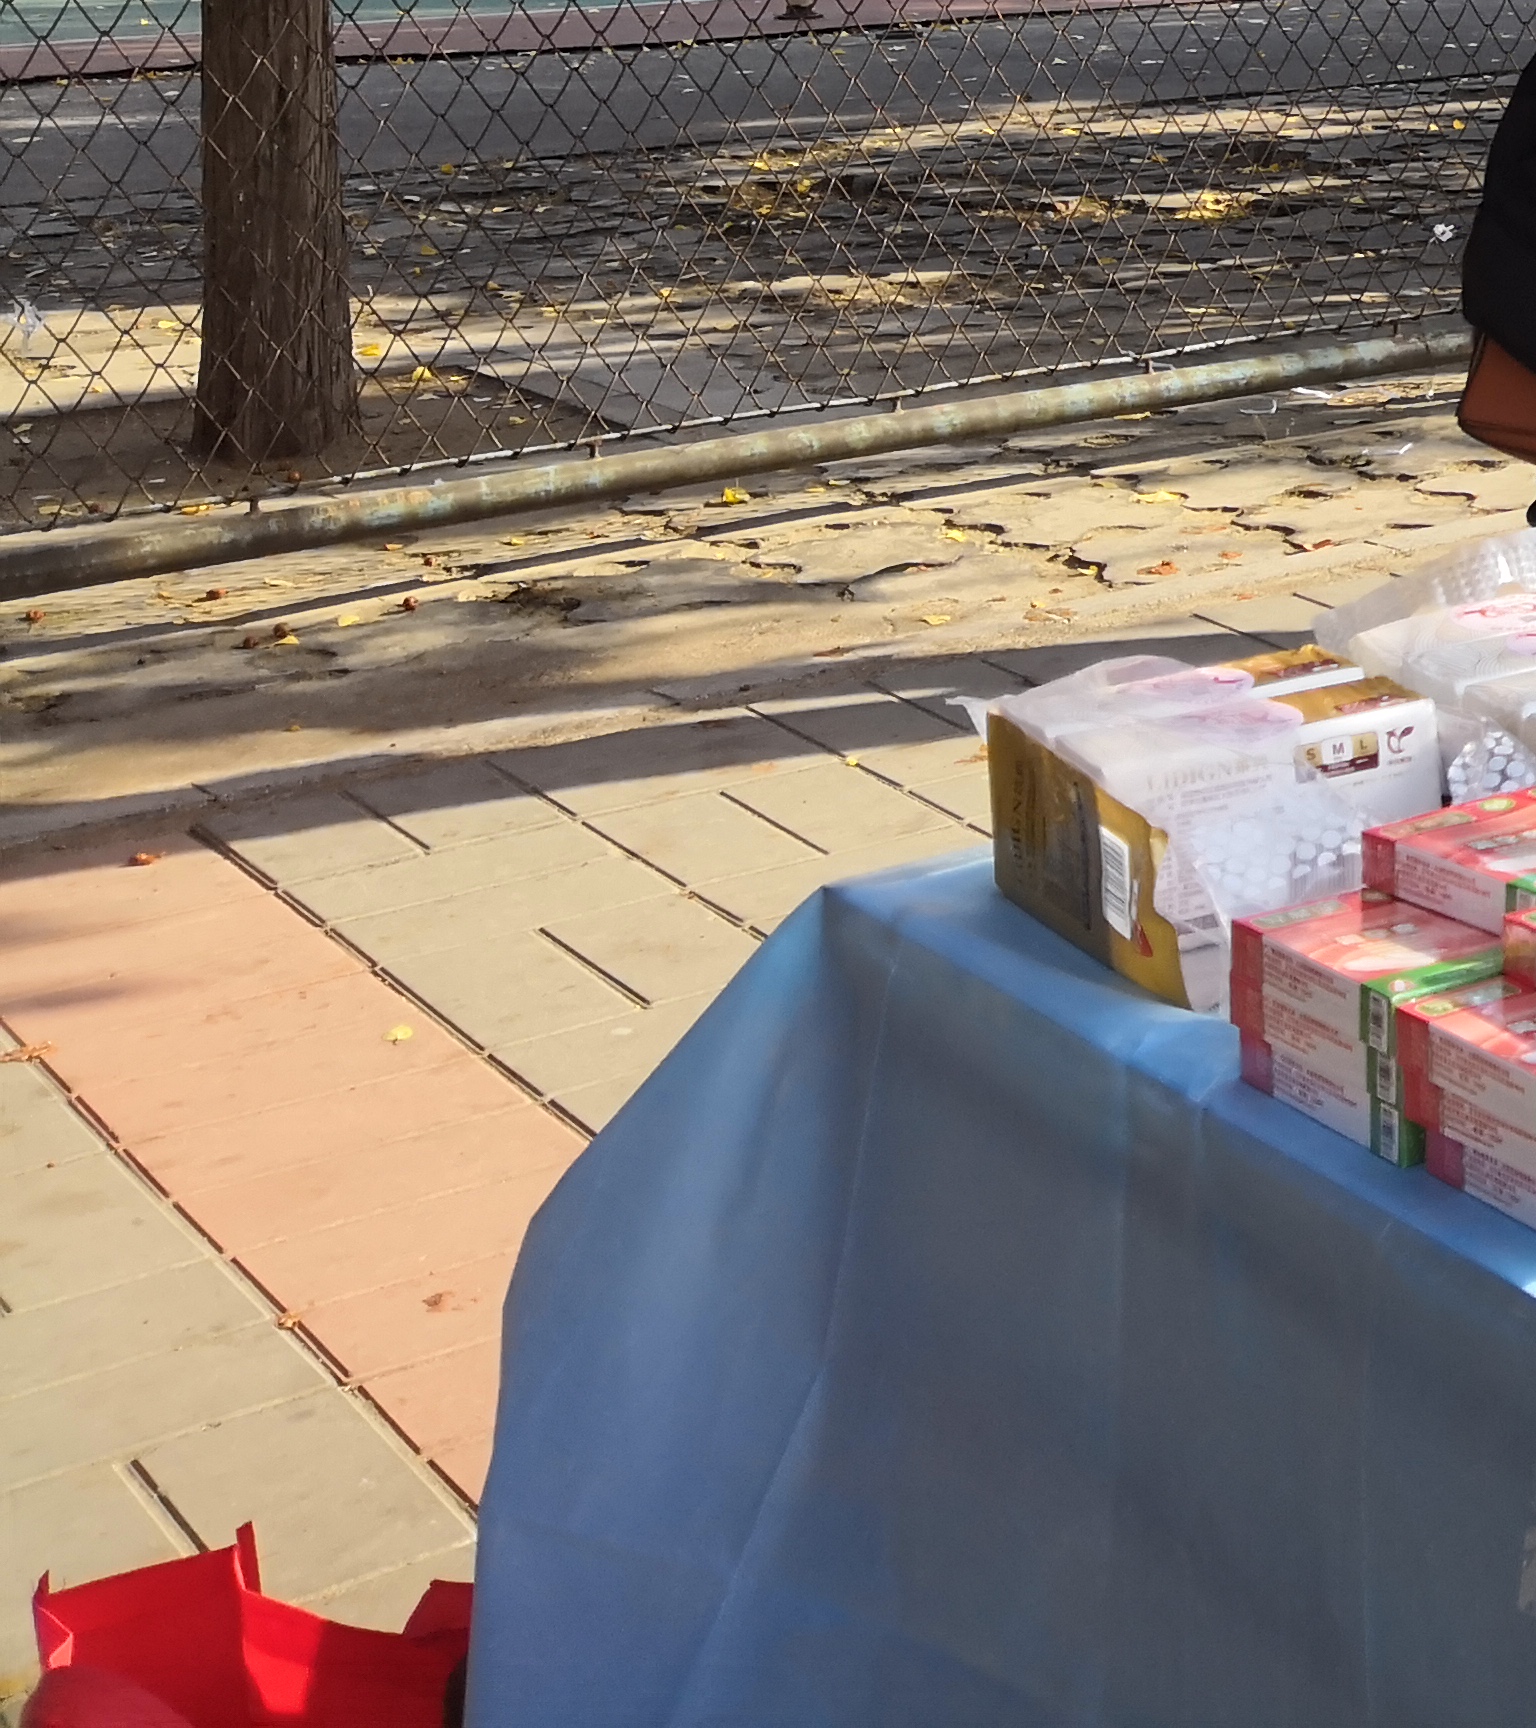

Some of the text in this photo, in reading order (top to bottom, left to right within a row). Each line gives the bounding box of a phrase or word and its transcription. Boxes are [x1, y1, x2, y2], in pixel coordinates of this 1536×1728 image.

[1306, 739, 1368, 761] S M L
